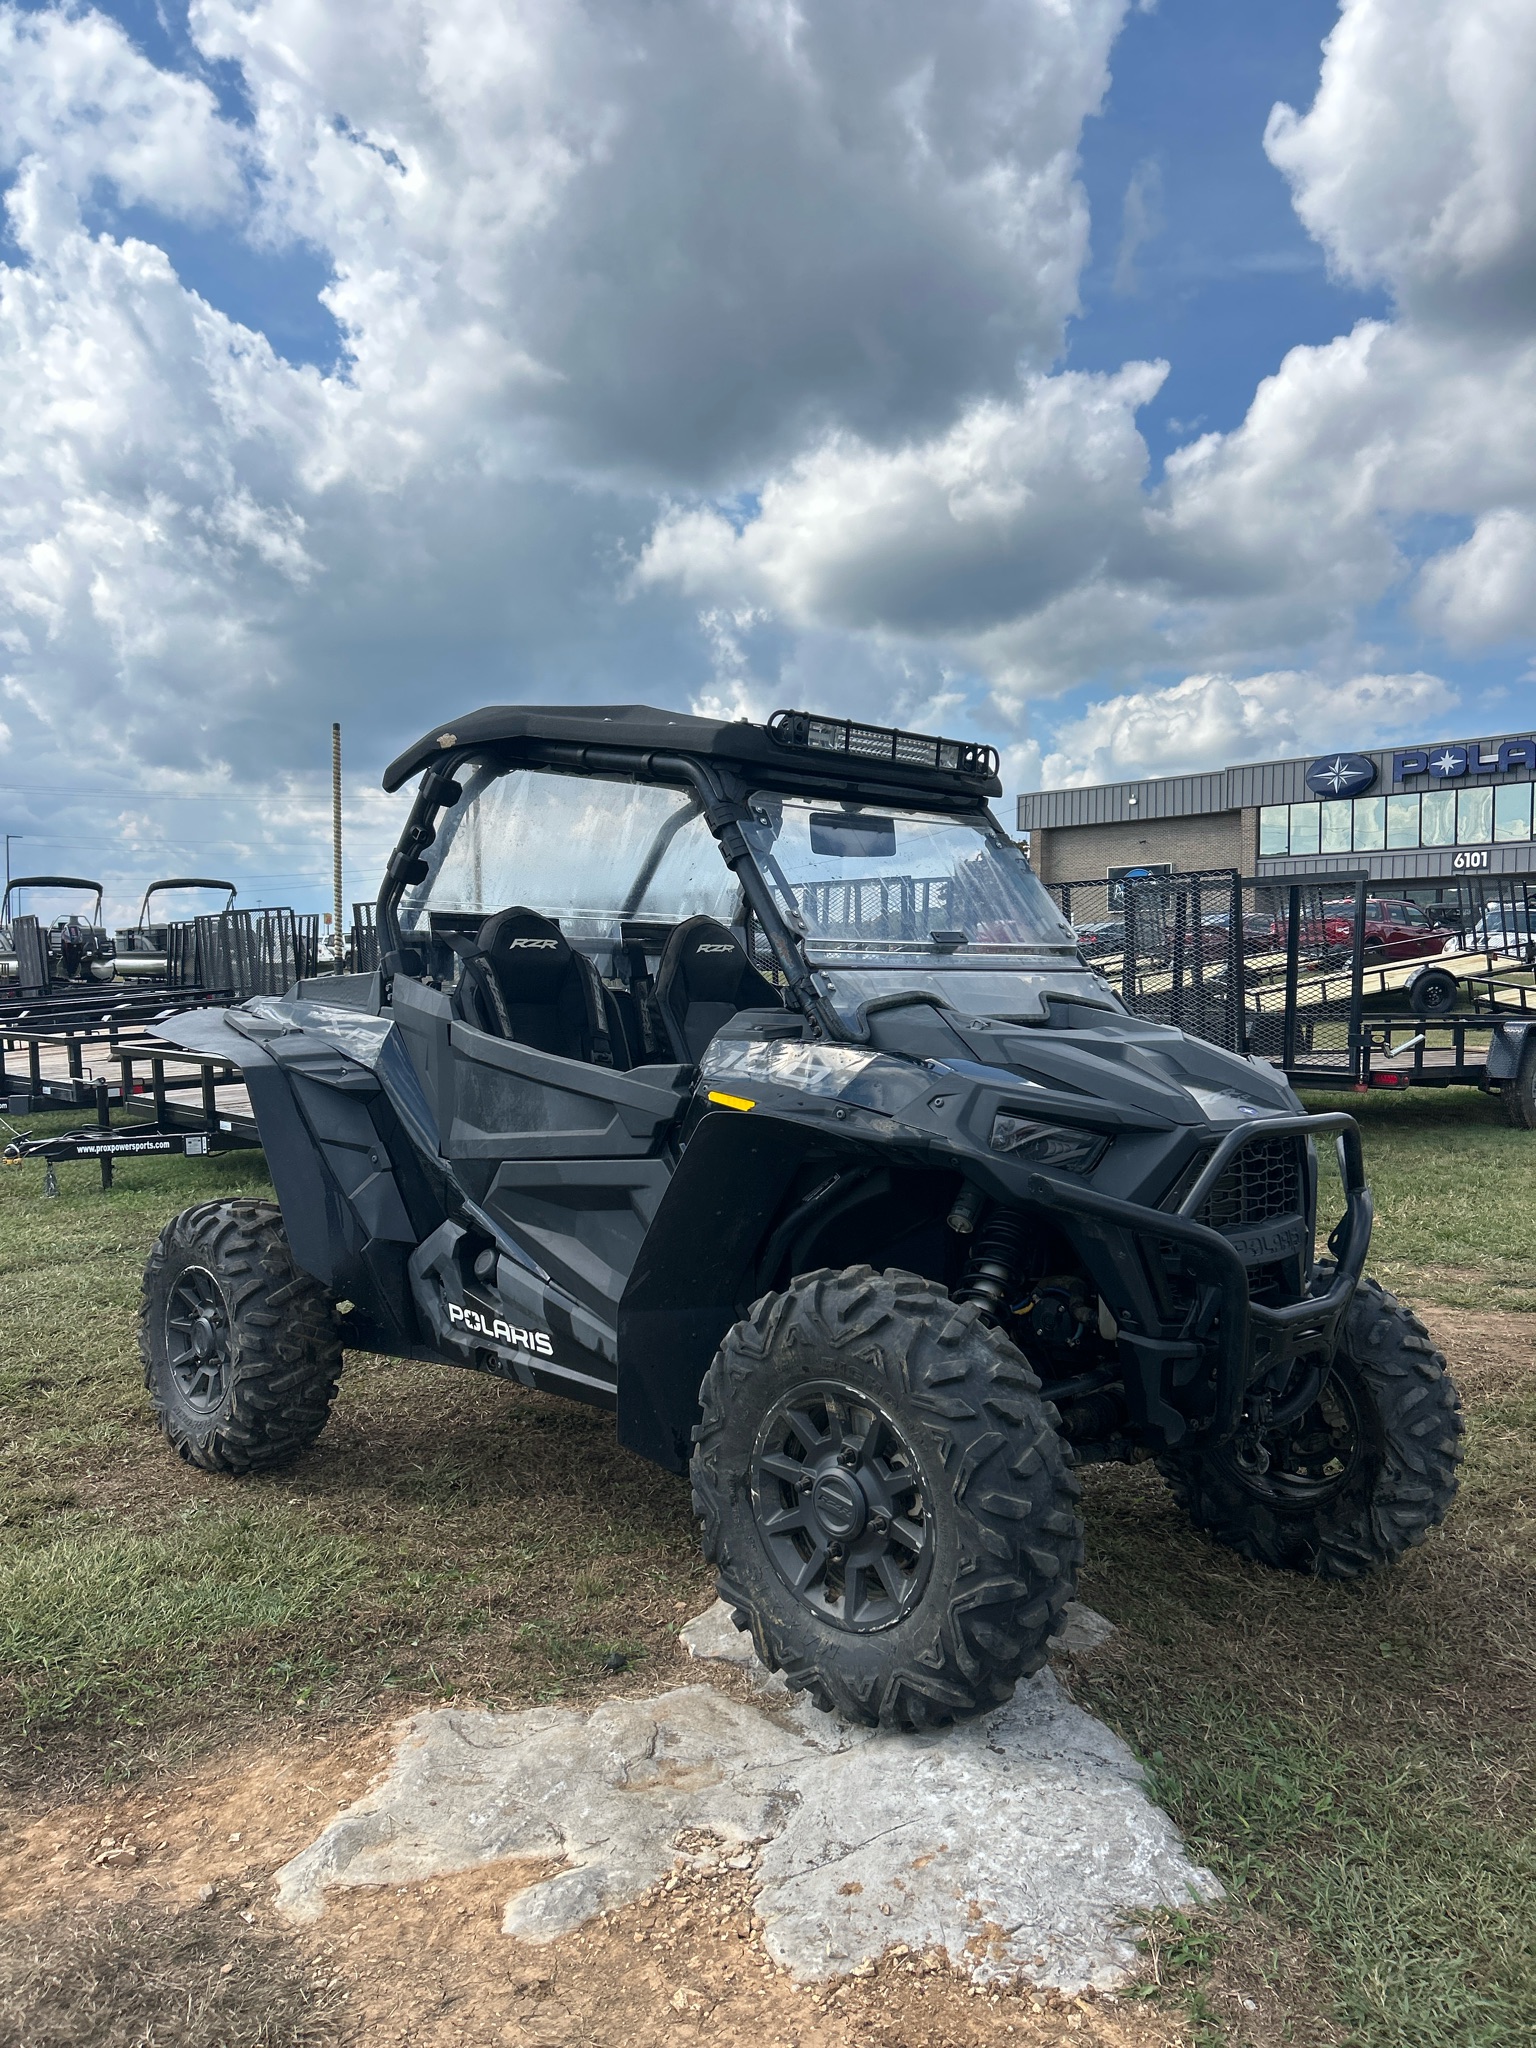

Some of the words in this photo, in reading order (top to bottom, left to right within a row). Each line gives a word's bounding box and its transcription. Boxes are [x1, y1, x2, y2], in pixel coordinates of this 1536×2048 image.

[1454, 852, 1487, 868] 6101
[509, 938, 559, 950] RZR
[696, 943, 735, 953] RZR
[77, 1141, 170, 1154] www.proxpowersports.com
[448, 1302, 554, 1356] POLARIS
